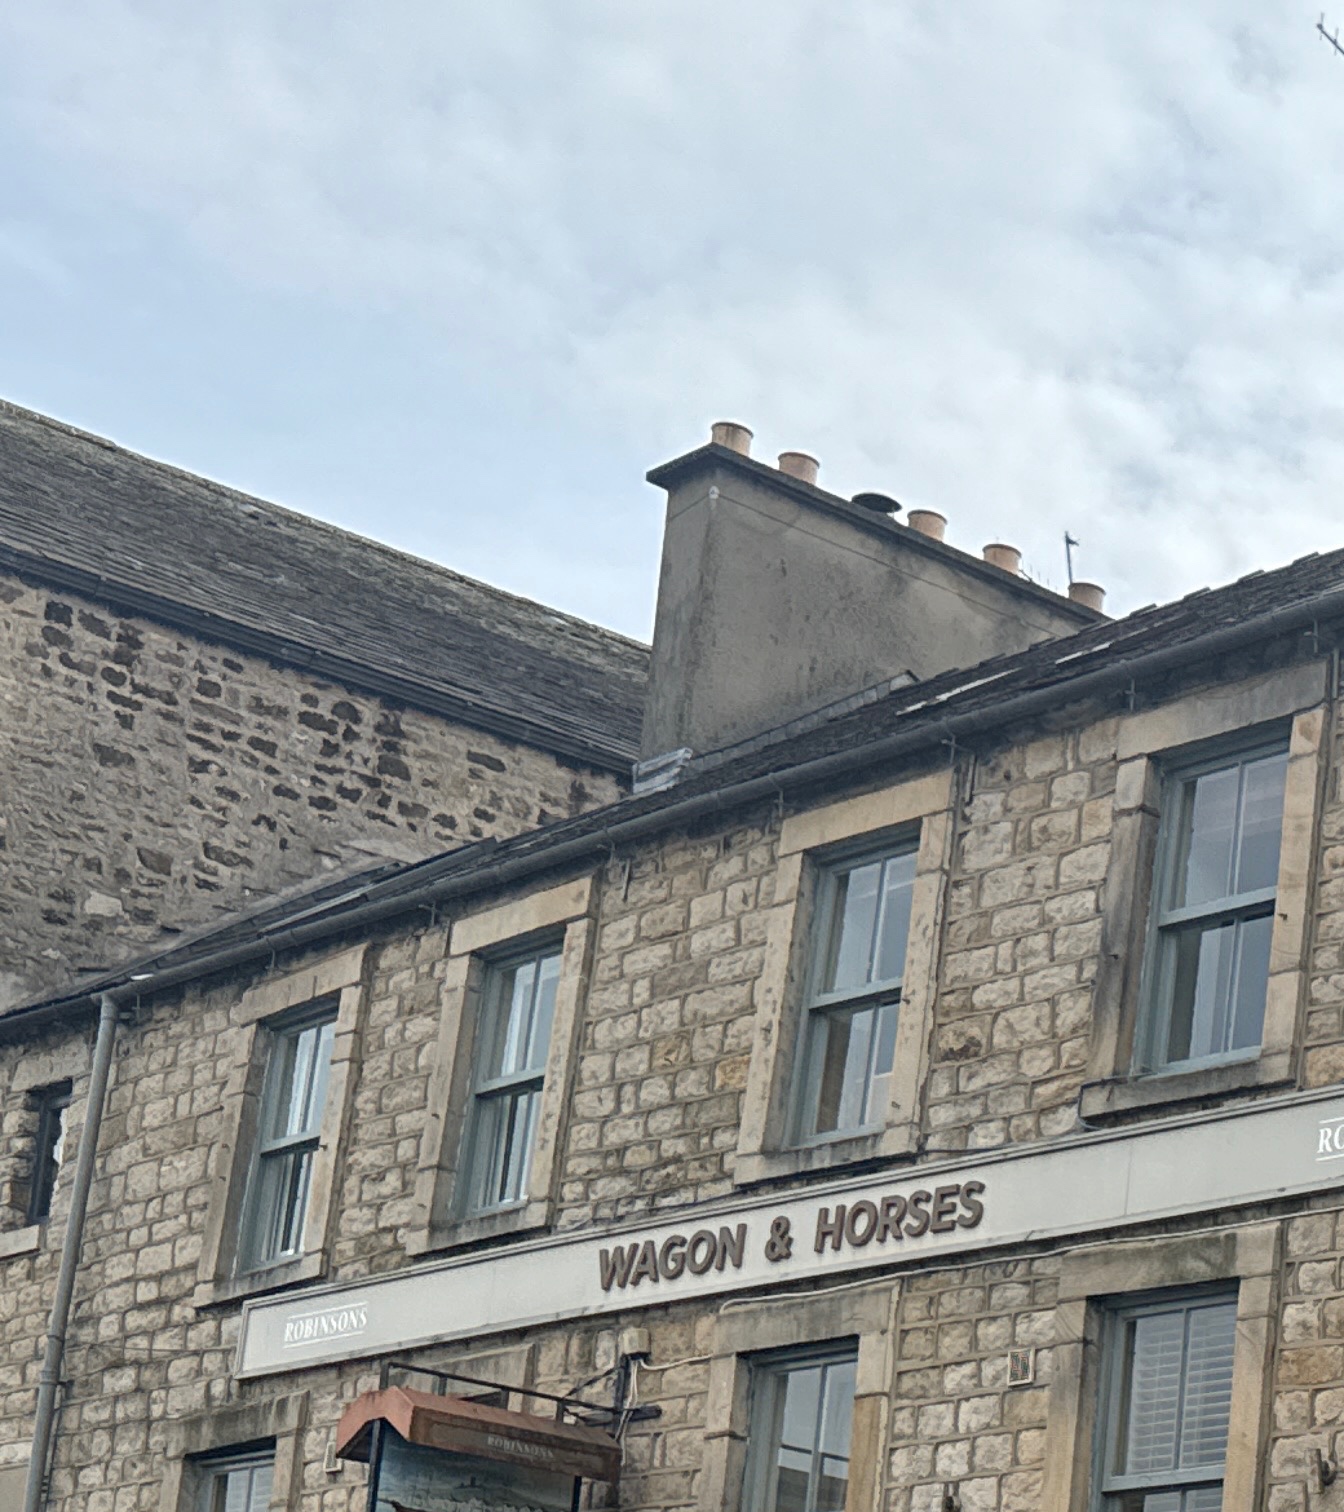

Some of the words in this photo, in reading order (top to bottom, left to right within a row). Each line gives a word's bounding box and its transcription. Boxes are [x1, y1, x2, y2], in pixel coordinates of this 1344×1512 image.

[600, 1222, 748, 1292] WAGON
[765, 1215, 793, 1261] &
[814, 1180, 985, 1253] HORSES
[284, 1307, 368, 1342] ROBINSONS
